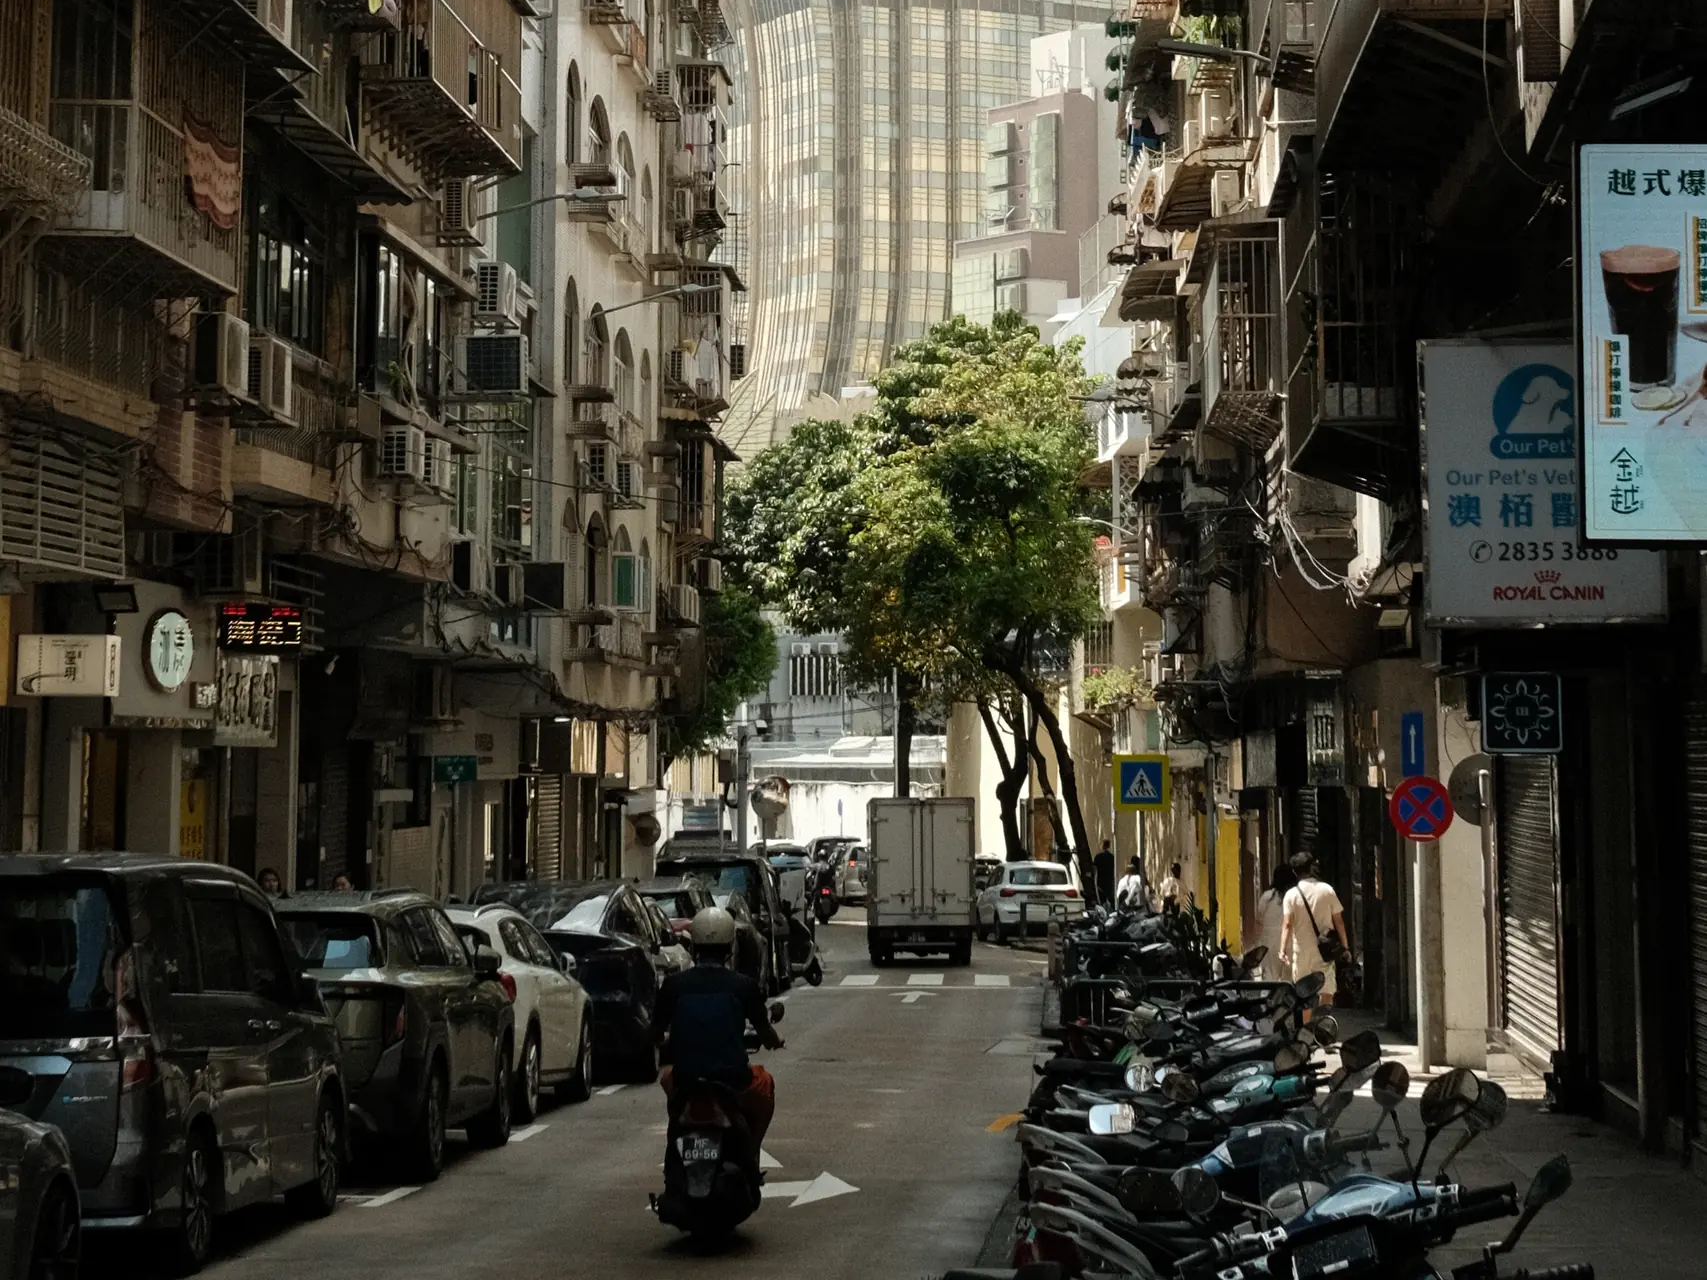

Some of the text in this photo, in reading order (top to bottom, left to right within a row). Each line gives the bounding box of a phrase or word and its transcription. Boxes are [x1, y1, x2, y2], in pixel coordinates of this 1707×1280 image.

[1607, 168, 1707, 197] 越式爆
[1499, 438, 1533, 454] Our
[1446, 470, 1483, 486] Our
[1489, 469, 1538, 486] Pet's
[1498, 541, 1554, 561] 2835
[1493, 585, 1605, 601] ROYAL CANIN
[694, 1138, 709, 1149] MF
